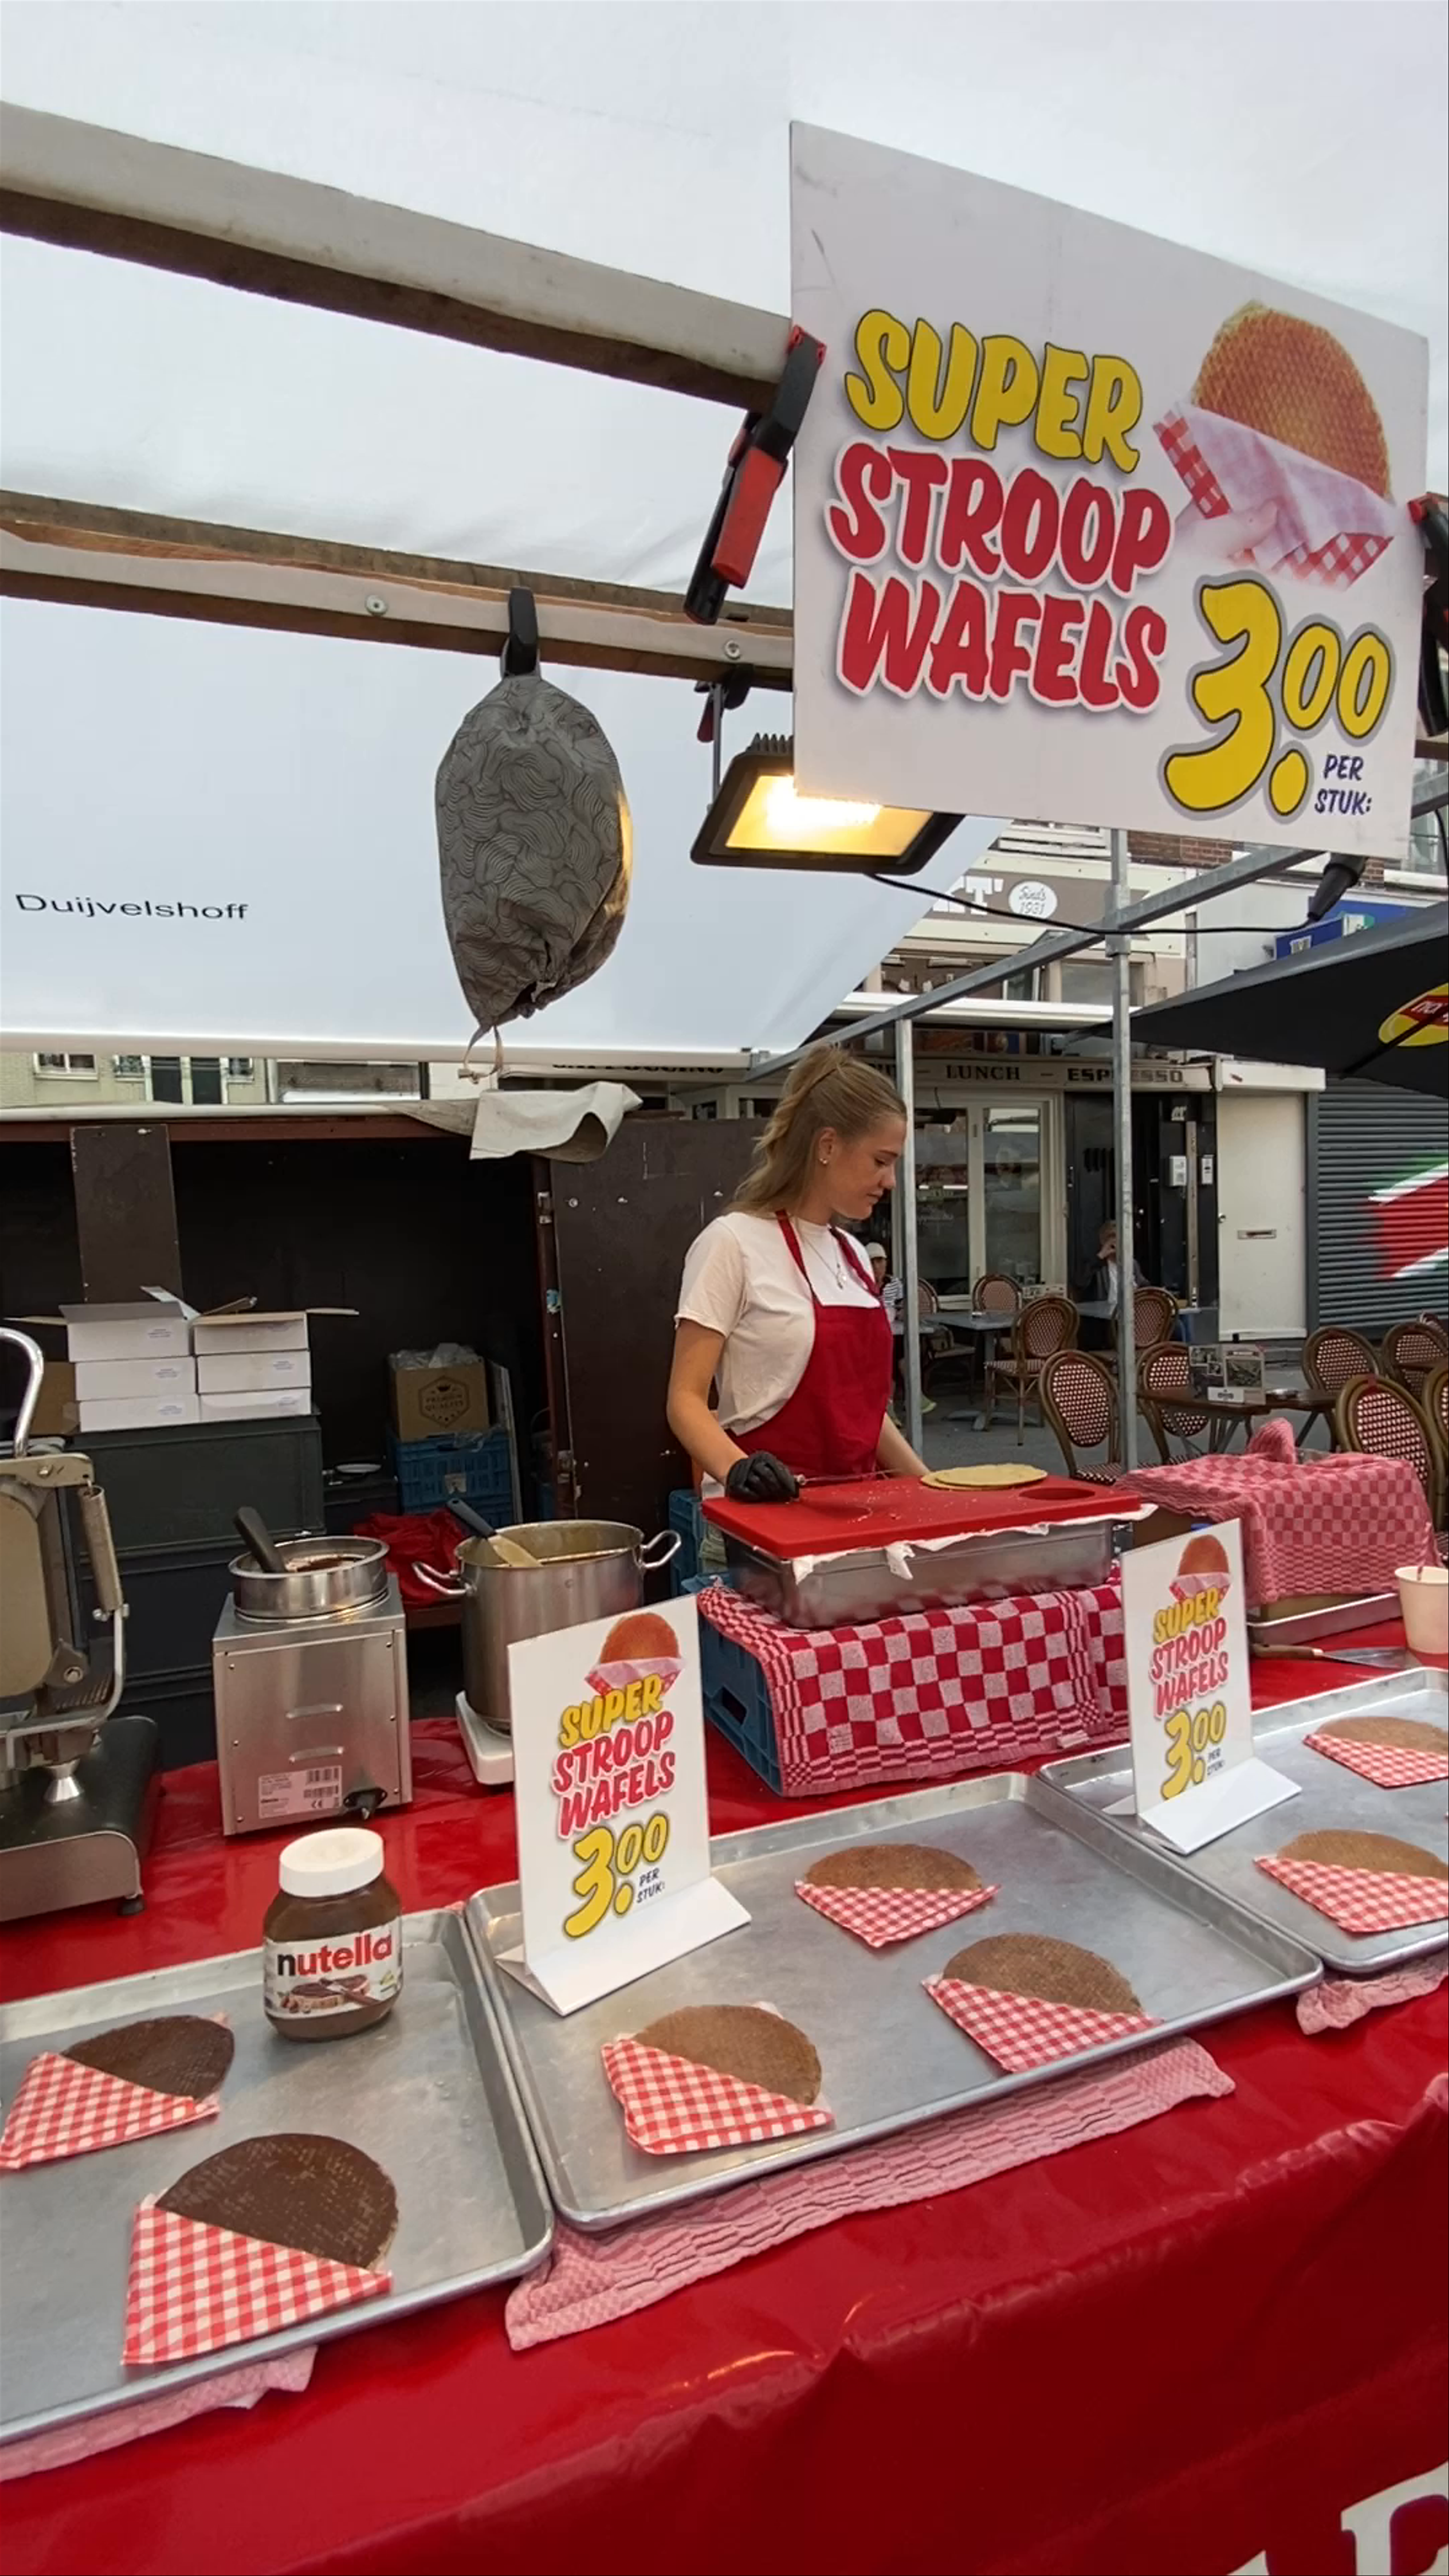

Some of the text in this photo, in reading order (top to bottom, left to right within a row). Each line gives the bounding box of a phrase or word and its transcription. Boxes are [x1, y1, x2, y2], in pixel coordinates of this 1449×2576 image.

[844, 309, 1143, 472] SUPER
[828, 442, 1172, 594] STROOP
[841, 575, 1167, 710] WAFELS
[1322, 754, 1363, 781] PER
[1314, 788, 1373, 816] STUK:
[15, 894, 248, 919] Duijvelshoff
[946, 1065, 1020, 1080] LUNCH
[1154, 1587, 1219, 1644] SUPER
[1151, 1617, 1226, 1681] STROOP
[559, 1675, 663, 1748] SUPER
[1155, 1651, 1228, 1718] WAFELS
[553, 1711, 674, 1793] STROOP
[558, 1751, 676, 1838] WAFELS
[639, 1868, 660, 1887] PER
[277, 1931, 392, 1976] nutella
